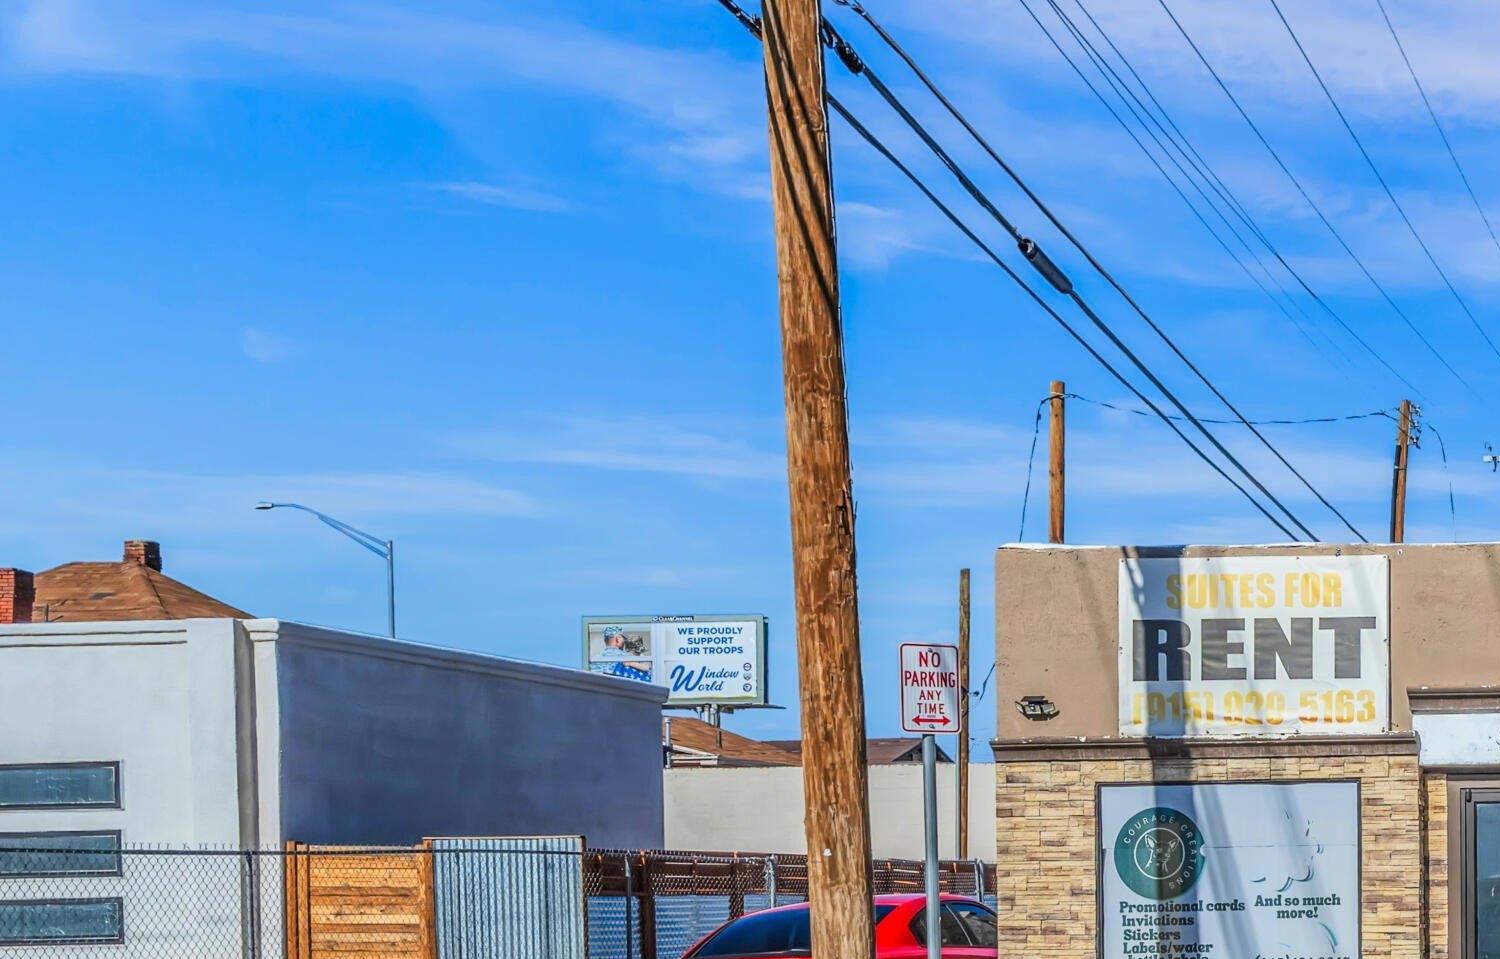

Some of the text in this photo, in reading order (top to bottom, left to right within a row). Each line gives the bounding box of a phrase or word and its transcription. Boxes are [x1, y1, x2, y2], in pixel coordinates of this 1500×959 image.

[1166, 572, 1342, 610] SUITES FOR
[677, 626, 743, 635] WE PROUDLY
[687, 637, 734, 645] SUPPORT
[678, 646, 744, 655] OUR TROOPS
[1132, 616, 1377, 682] RENT
[918, 651, 941, 668] NO
[904, 671, 956, 688] PARKING
[918, 689, 942, 701] ANY
[916, 702, 945, 714] TIME
[1123, 814, 1198, 889] COURAGE CREATIONS
[1119, 899, 1246, 913] Promotional cards
[1254, 893, 1341, 907] And so much
[1276, 907, 1319, 919] more!
[1121, 914, 1195, 926] Invitations
[1123, 929, 1181, 941] Stickers
[1123, 942, 1213, 954] Labels/water
